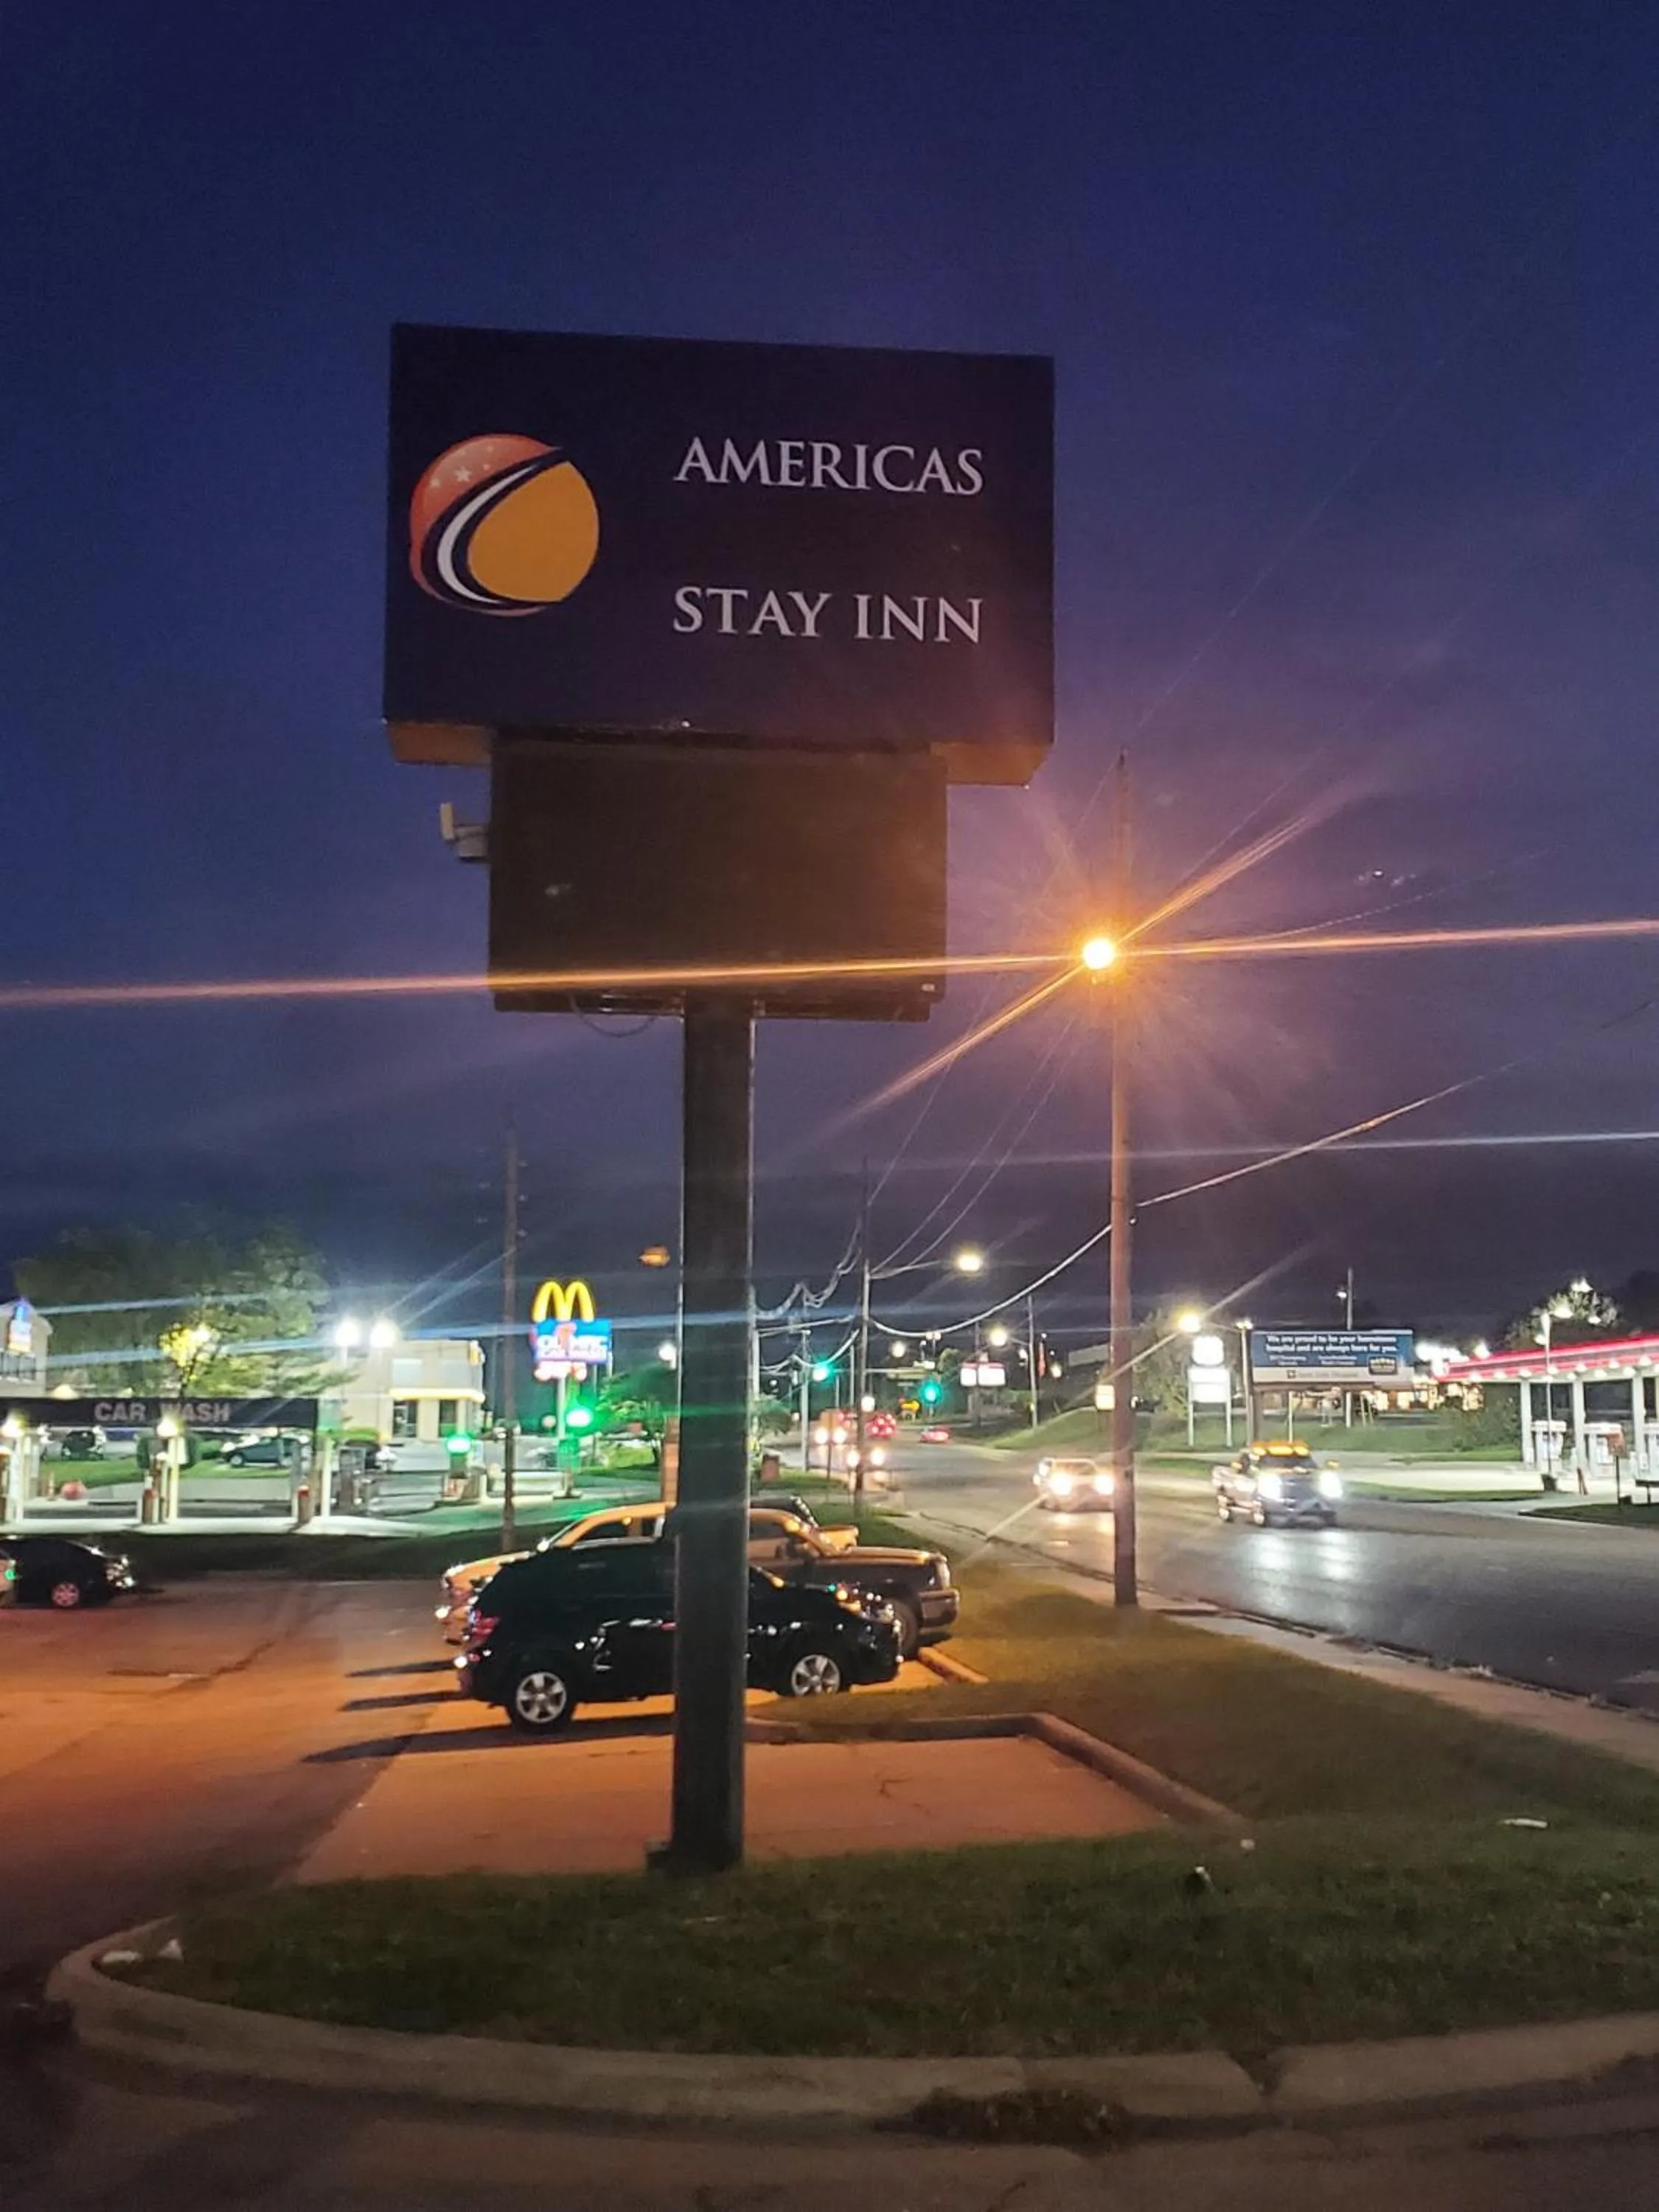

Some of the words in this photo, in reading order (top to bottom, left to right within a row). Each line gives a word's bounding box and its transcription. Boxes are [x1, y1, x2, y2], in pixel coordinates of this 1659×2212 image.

[673, 437, 984, 496] AMERICAS
[673, 587, 832, 639] STAY
[854, 594, 984, 645] INN
[94, 1402, 146, 1422] CAR
[159, 1402, 231, 1422] WASH
